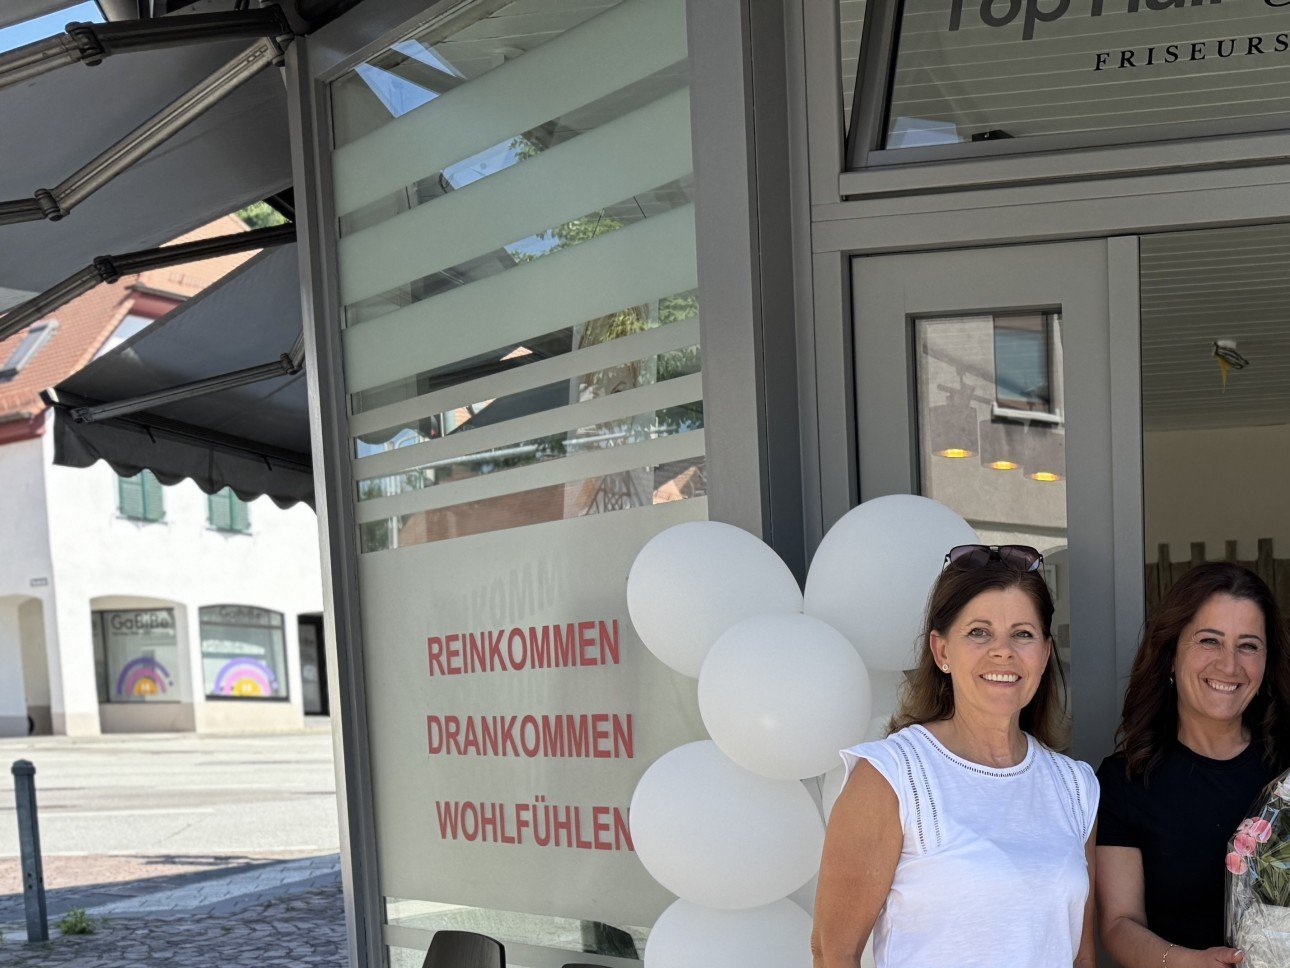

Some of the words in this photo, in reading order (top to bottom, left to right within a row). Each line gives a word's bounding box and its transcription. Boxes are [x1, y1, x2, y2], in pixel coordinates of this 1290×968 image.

[427, 619, 620, 676] REINKOMMEN
[427, 713, 634, 759] DRANKOMMEN
[435, 795, 635, 851] WOHLFÜHLEN
